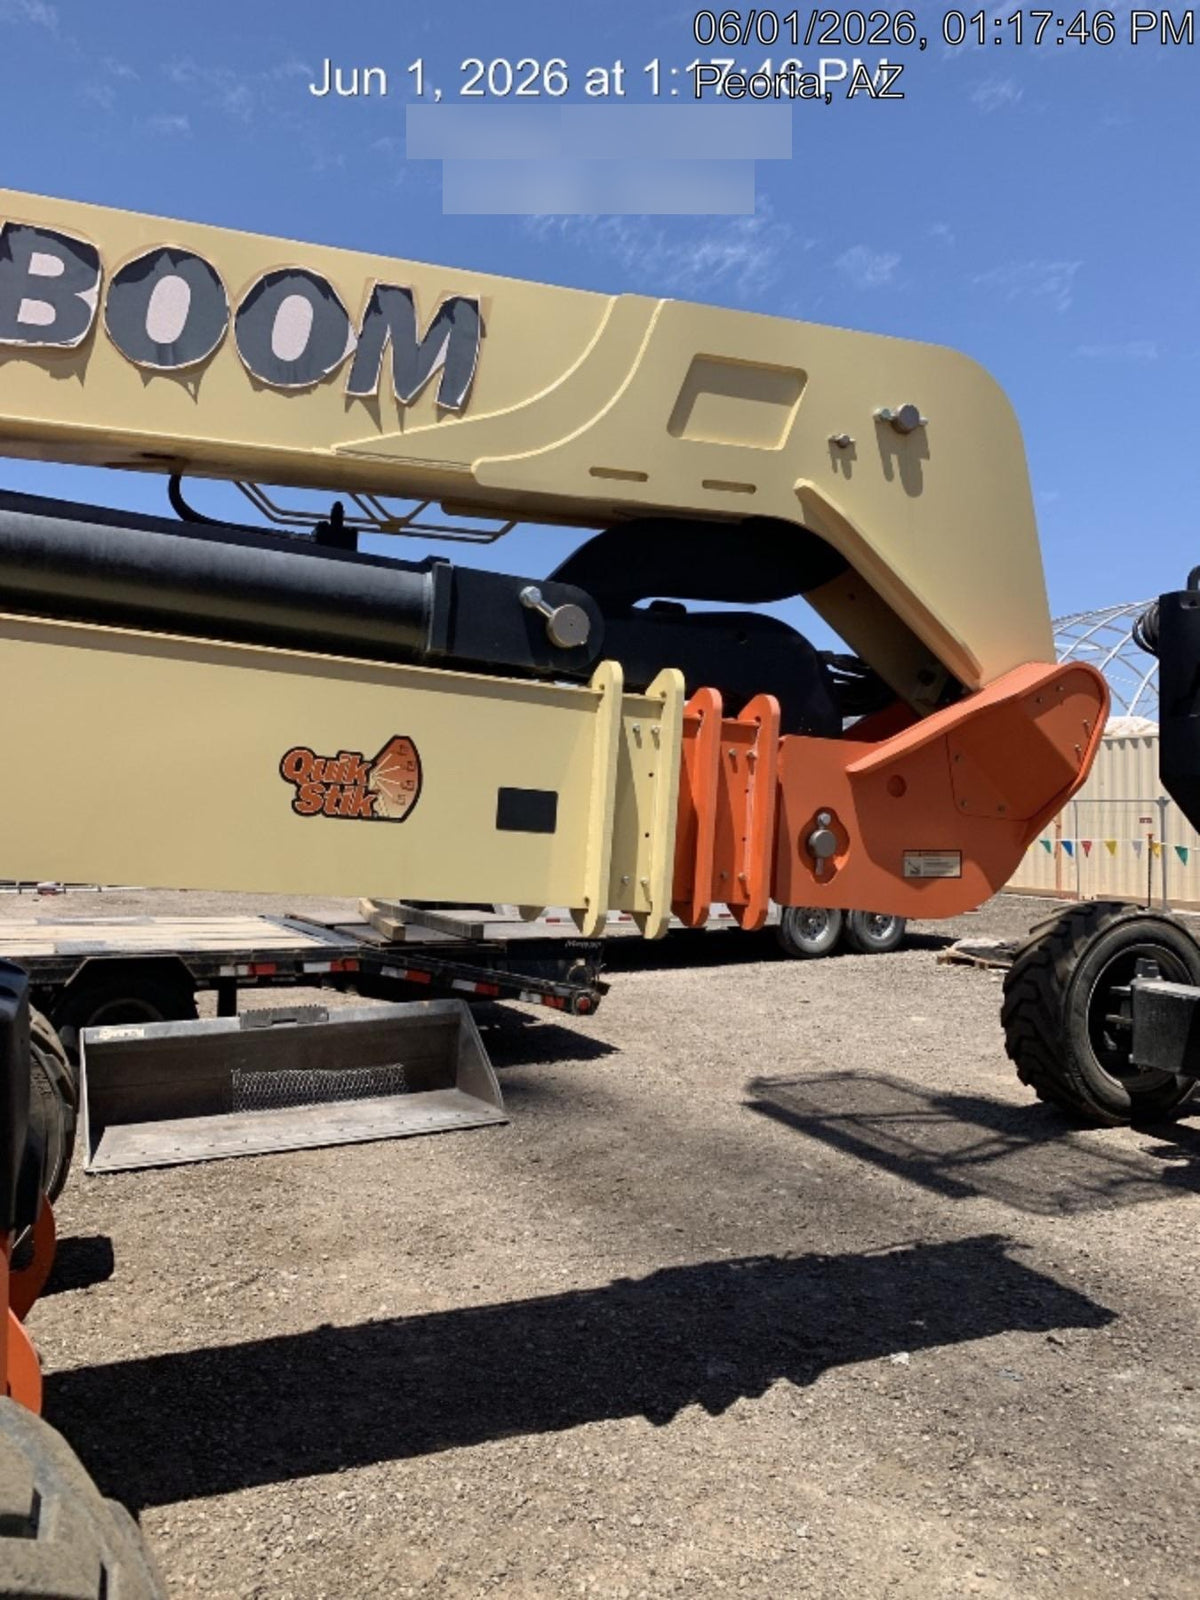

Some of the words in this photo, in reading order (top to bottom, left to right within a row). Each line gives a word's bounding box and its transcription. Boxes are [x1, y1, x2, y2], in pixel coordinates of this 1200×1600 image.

[0, 221, 485, 411] BOOM
[281, 748, 372, 786] Quik
[294, 783, 376, 817] Stik
